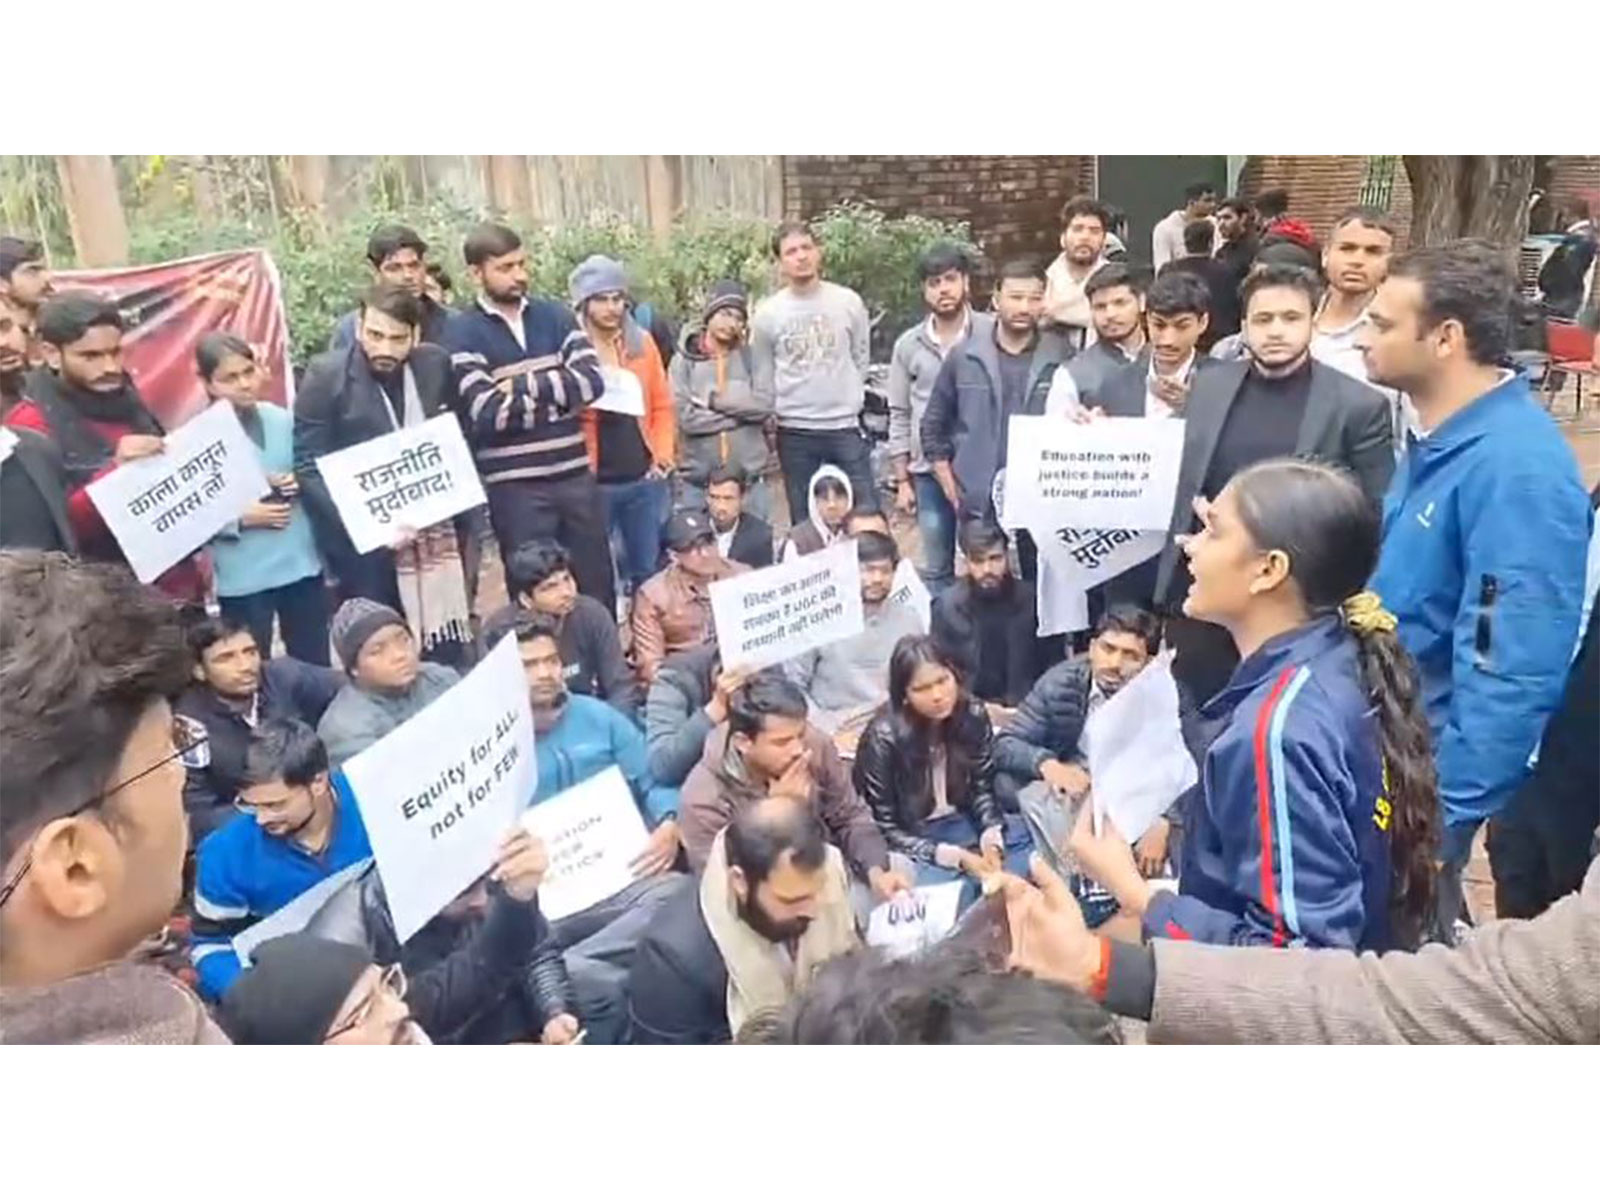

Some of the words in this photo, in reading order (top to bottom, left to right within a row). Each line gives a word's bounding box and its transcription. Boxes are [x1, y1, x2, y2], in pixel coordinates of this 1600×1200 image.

[127, 474, 179, 516] काला
[177, 439, 227, 482] कानून
[354, 442, 442, 492] राजनीति
[1039, 469, 1089, 483] justice
[1140, 472, 1150, 481] a
[1041, 450, 1115, 463] Education
[1118, 452, 1151, 463] with
[151, 491, 202, 533] वापस
[200, 472, 226, 499] लो
[365, 470, 453, 524] मुर्दाबाद!
[401, 760, 466, 820] Equity
[469, 737, 492, 766] for
[430, 801, 465, 840] not
[467, 777, 492, 809] for
